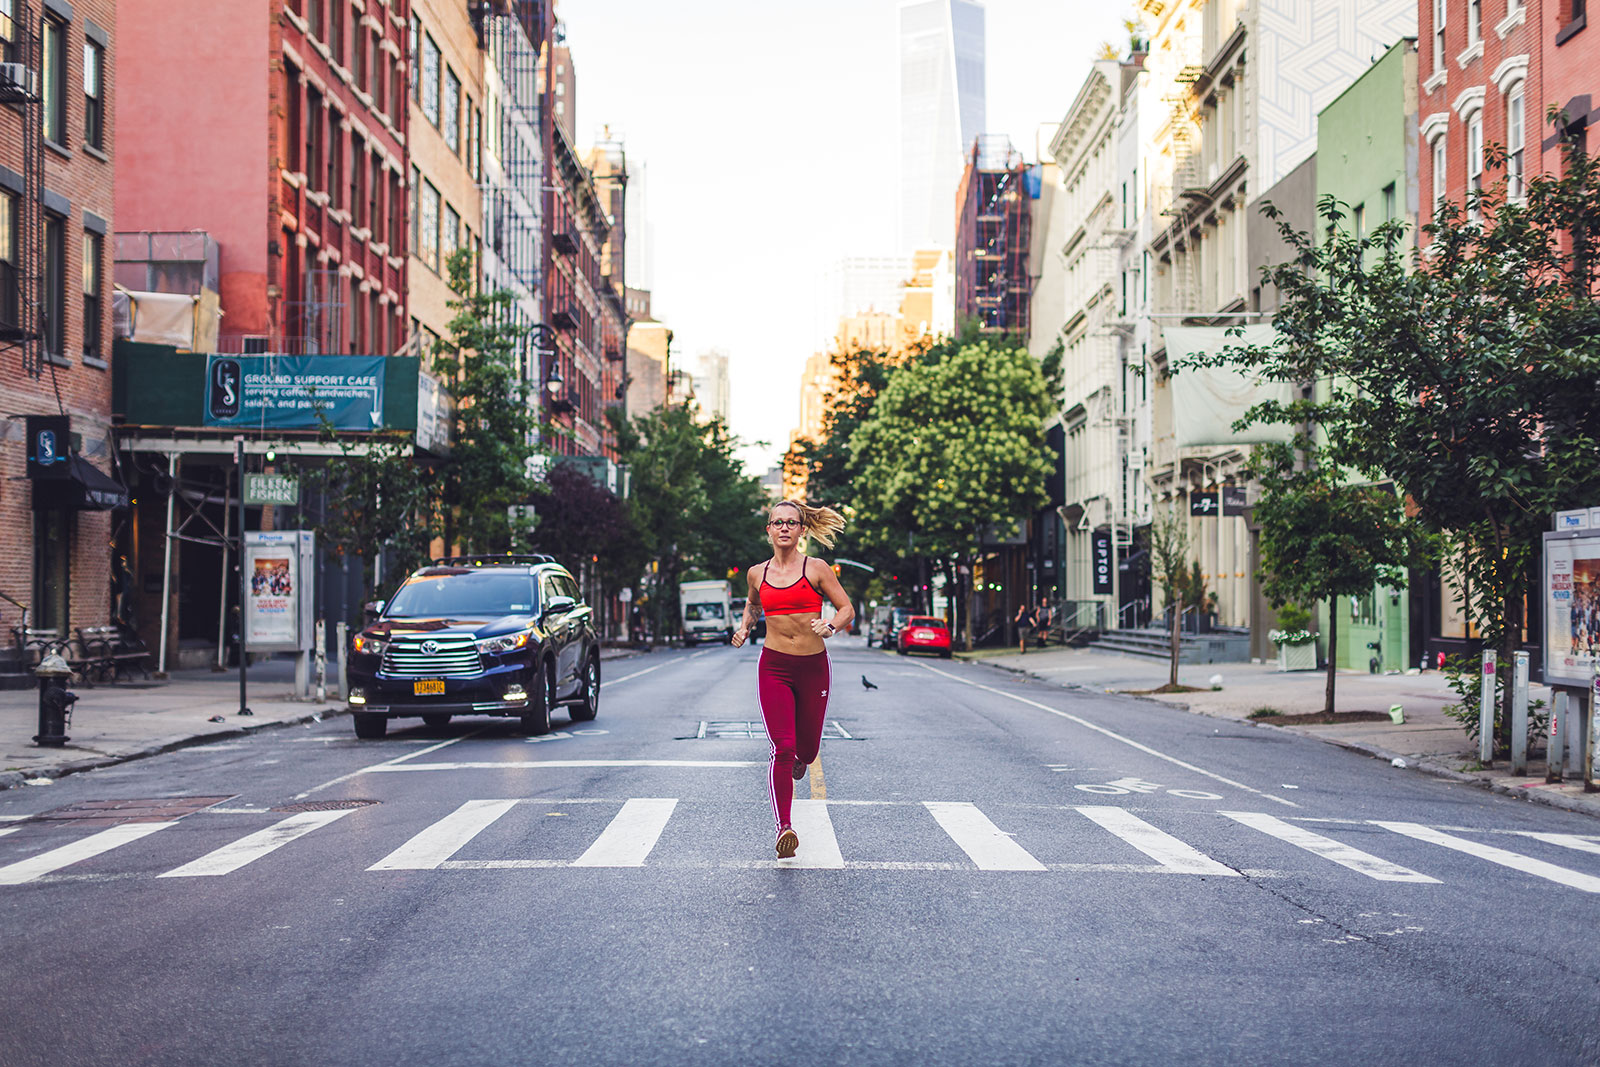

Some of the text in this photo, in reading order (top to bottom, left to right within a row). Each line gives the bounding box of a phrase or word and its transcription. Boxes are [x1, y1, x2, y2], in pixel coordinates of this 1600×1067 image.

[244, 374, 377, 386] GROUND SUPPORT CAFE
[244, 388, 278, 397] serving
[314, 389, 371, 398] sandwiches,
[277, 400, 296, 409] and
[250, 477, 292, 489] EILEEN
[250, 489, 292, 501] FISHER
[1097, 539, 1109, 584] UPTON
